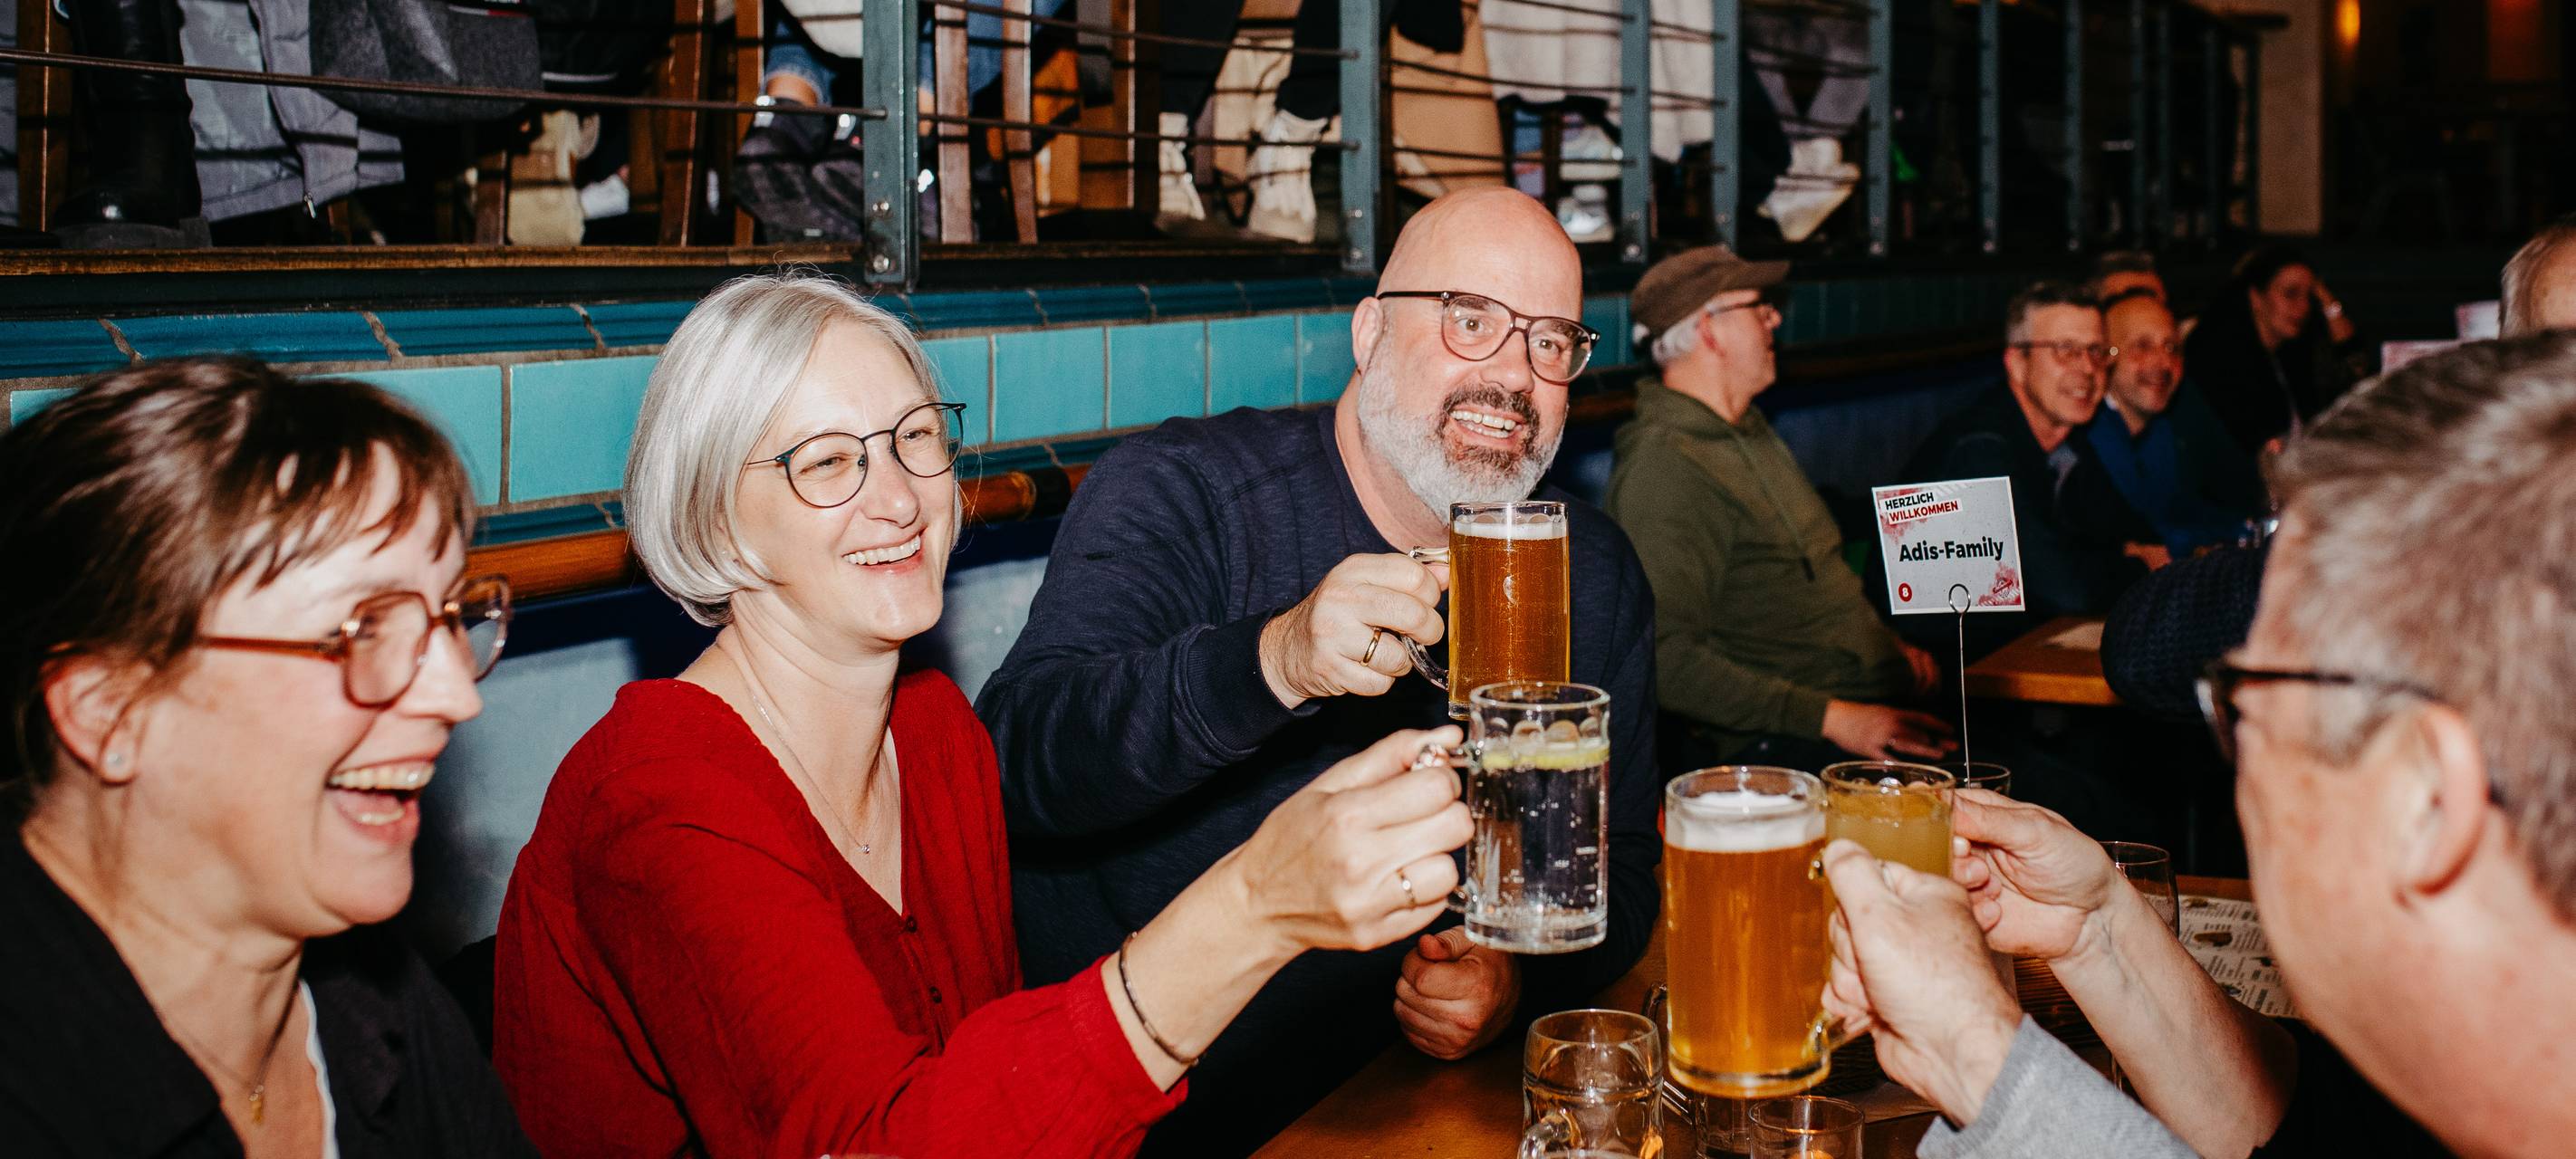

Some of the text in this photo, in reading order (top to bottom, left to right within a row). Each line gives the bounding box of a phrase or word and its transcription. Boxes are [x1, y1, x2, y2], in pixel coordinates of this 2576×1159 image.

[1885, 493, 1934, 510] HERZLICH
[1889, 501, 1958, 522] WILLKOMMEN
[1899, 536, 2004, 561] Adis-Family
